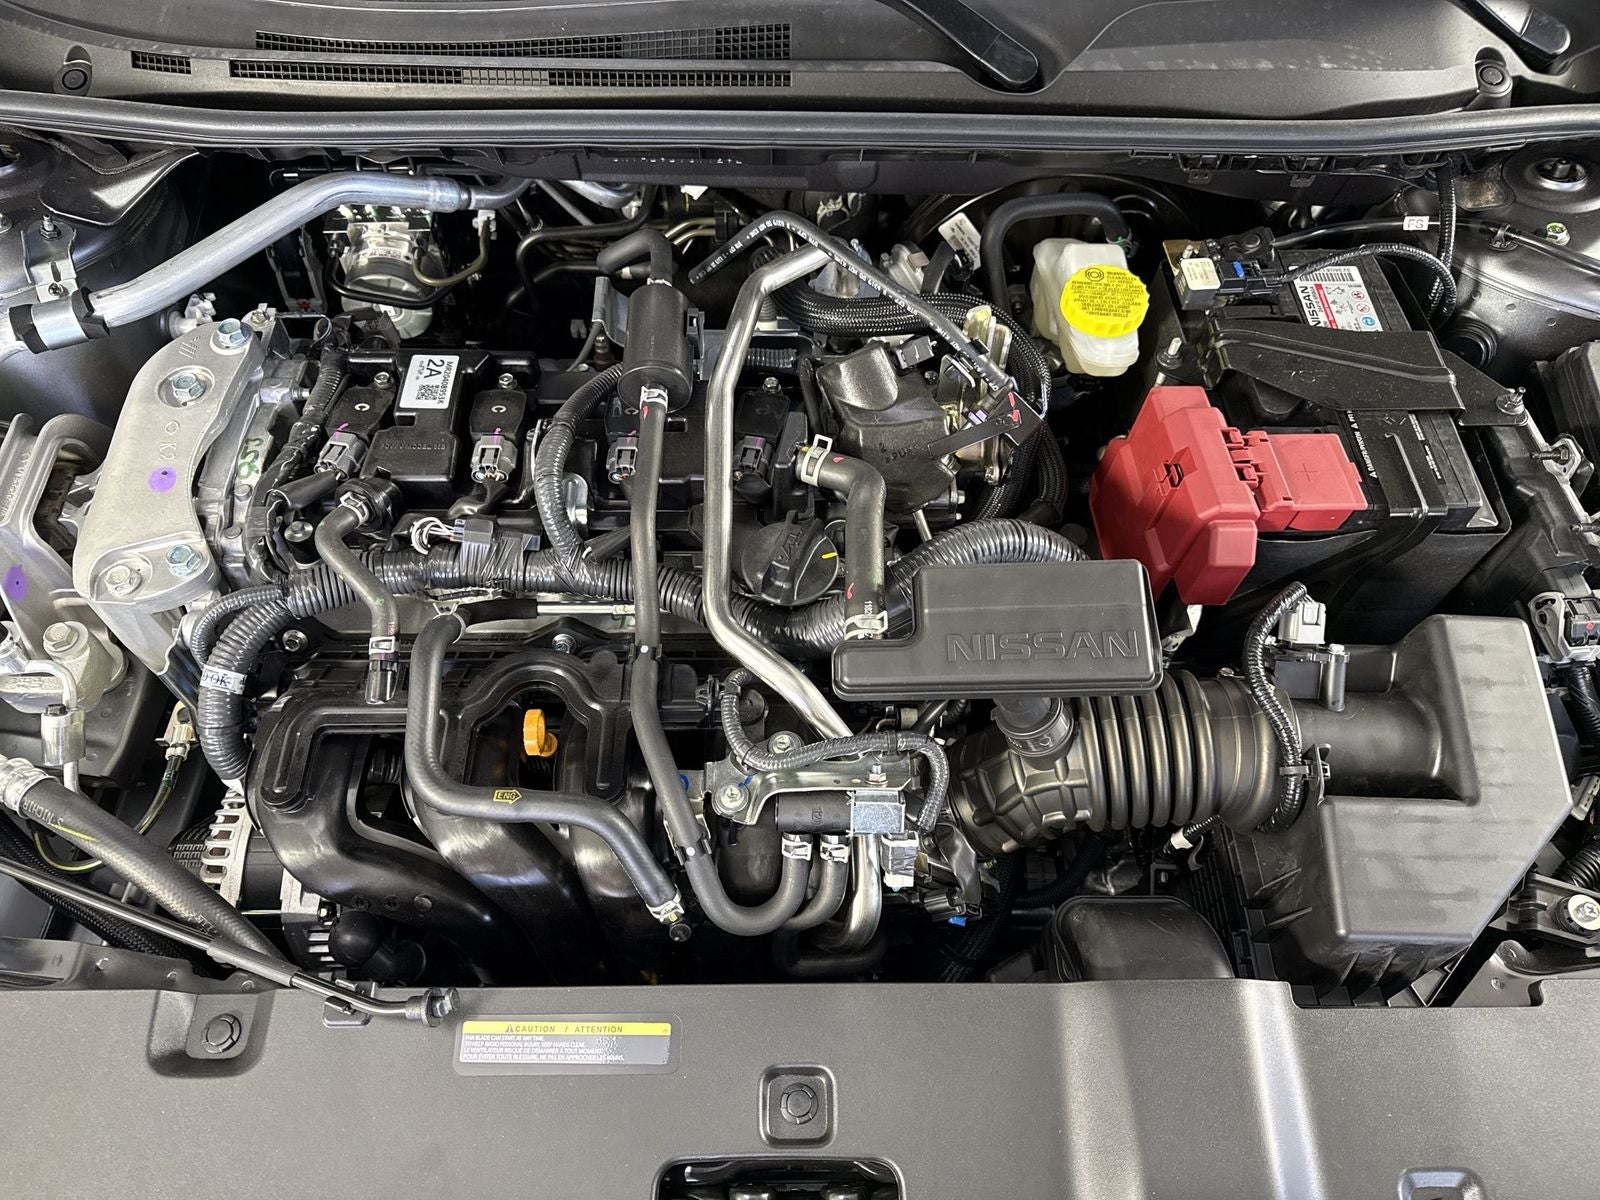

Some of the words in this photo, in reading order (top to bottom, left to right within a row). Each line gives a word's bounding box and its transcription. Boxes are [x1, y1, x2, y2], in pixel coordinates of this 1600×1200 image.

[1299, 286, 1322, 326] NISSAN
[424, 359, 444, 378] 2A
[946, 630, 1140, 662] NISSAN
